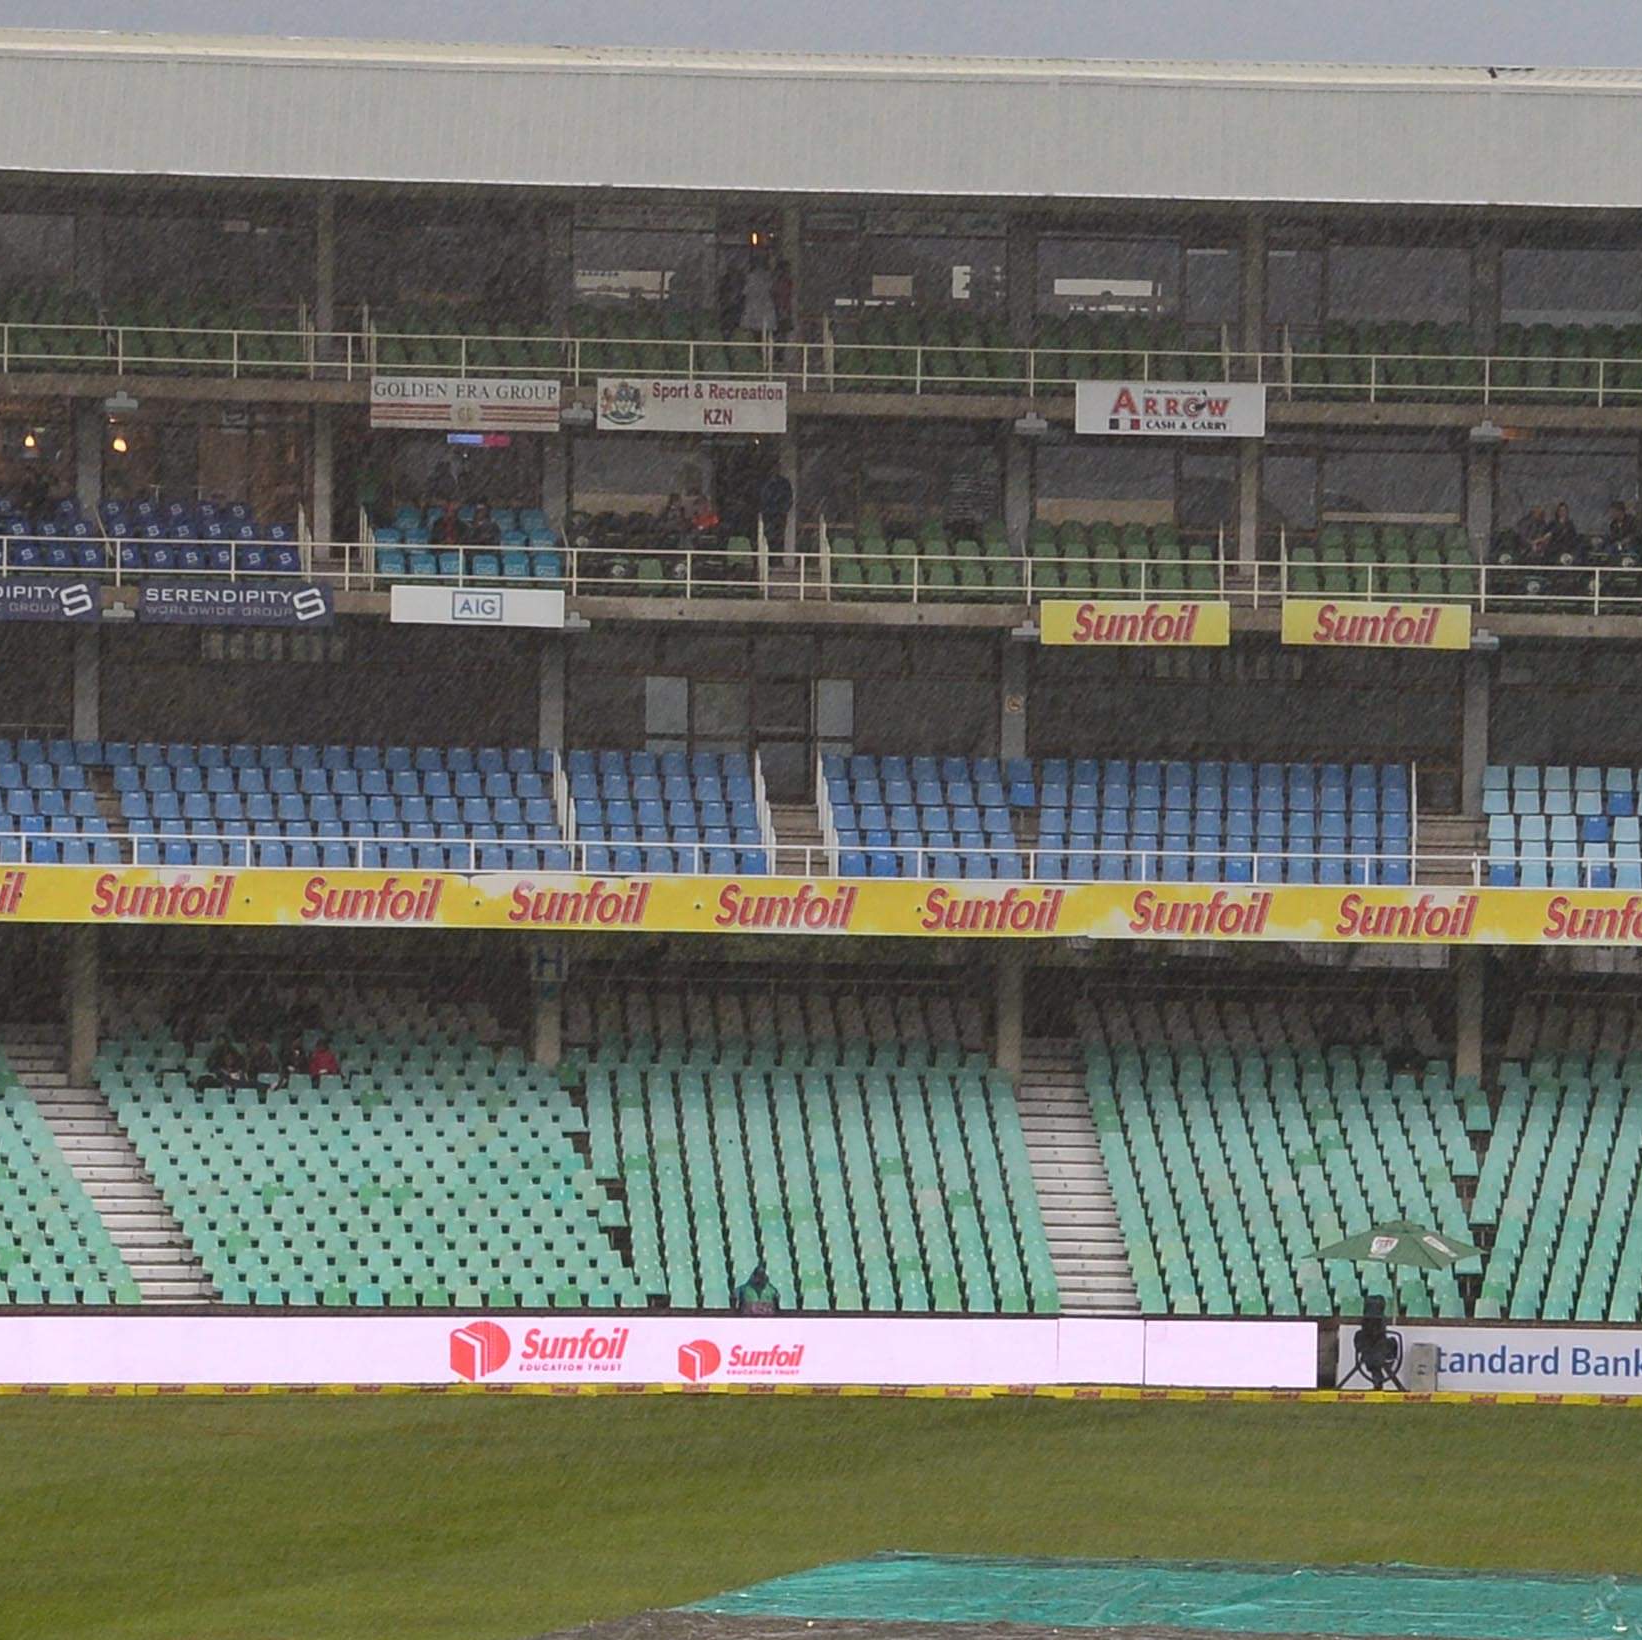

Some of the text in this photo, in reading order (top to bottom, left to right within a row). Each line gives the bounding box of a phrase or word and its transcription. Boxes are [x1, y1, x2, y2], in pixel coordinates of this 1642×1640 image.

[374, 382, 557, 400] GOLDEN ERA GROUP
[652, 382, 784, 400] Sport & Recreation
[1111, 386, 1232, 417] ARROW
[703, 408, 733, 425] KZN
[1146, 422, 1176, 430] CASH
[1192, 422, 1228, 431] CARRY
[9, 602, 60, 614] GROUP
[145, 588, 294, 604] SERENDIPITY
[460, 600, 496, 615] AIG
[146, 605, 293, 619] WORLDWIDE GROUP
[1072, 603, 1199, 643] Sunfoil
[1313, 603, 1441, 645] Sunfoil
[92, 874, 234, 916] Sunfoil
[301, 877, 443, 919] Sunfoil
[509, 881, 649, 923] Sunfoil
[715, 884, 857, 926] Sunfoil
[922, 888, 1062, 931] Sunfoil
[1130, 891, 1270, 933] Sunfoil
[1337, 894, 1478, 935] Sunfoil
[521, 1327, 630, 1361] Sunfoil
[728, 1343, 805, 1368] Sunfoil
[519, 1363, 622, 1372] EDUCATION TRUST
[1436, 1346, 1558, 1374] tandard
